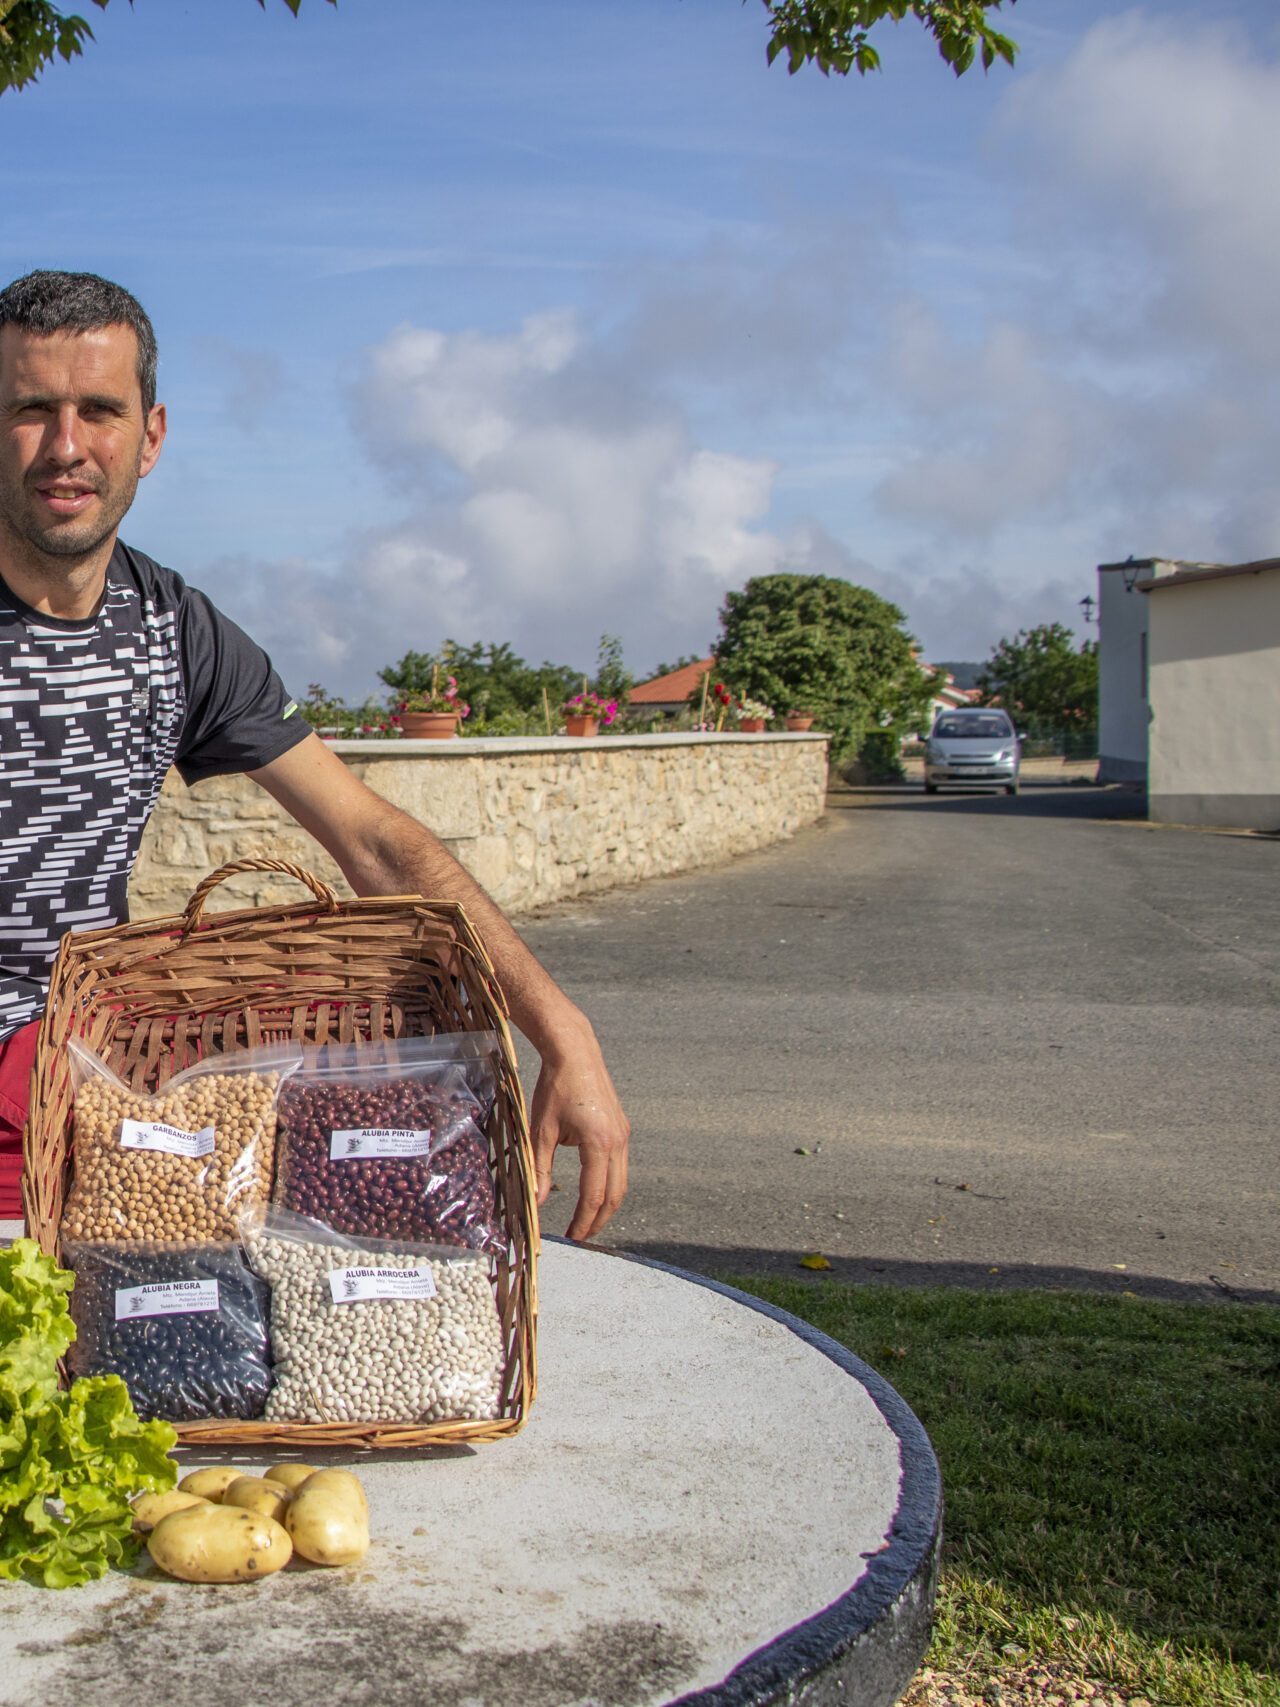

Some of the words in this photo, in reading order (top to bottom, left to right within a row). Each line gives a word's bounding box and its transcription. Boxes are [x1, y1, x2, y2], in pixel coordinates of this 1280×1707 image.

[152, 1124, 197, 1141] GARBANZOS
[346, 1270, 375, 1278] ALUBIA
[377, 1270, 419, 1278] ARROCERA
[142, 1284, 171, 1294] ALUBIA
